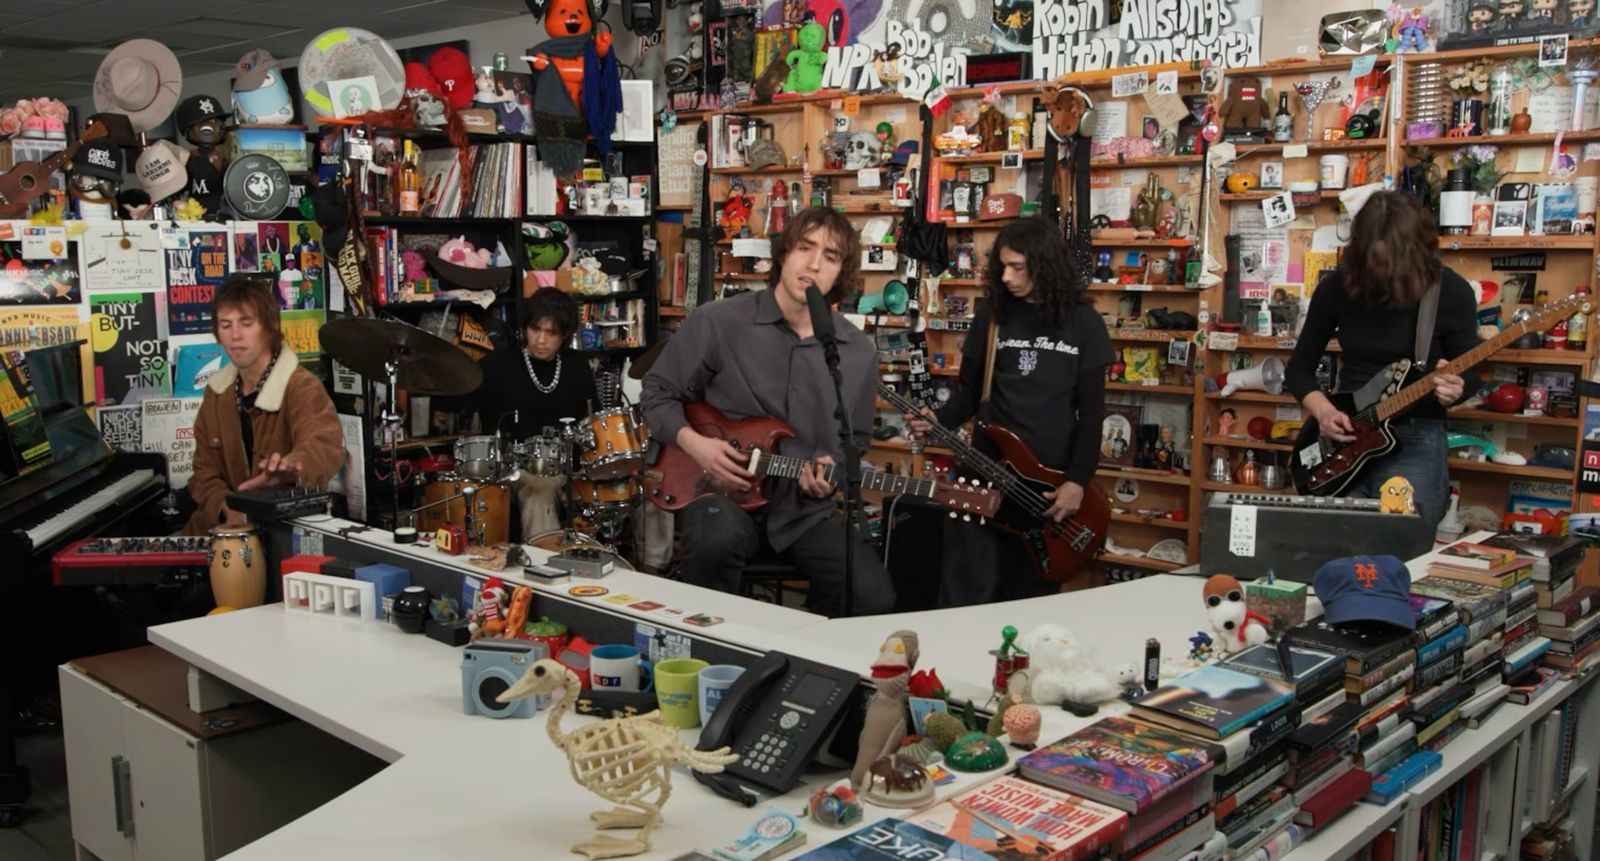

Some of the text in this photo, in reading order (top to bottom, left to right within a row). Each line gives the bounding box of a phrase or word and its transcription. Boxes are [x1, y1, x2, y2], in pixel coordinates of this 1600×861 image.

[886, 18, 932, 59] Bob
[1034, 32, 1121, 80] Hilton
[823, 44, 886, 90] NPR
[898, 42, 968, 98] Boilen
[445, 79, 456, 91] P
[658, 129, 695, 149] hilip
[192, 179, 208, 194] M
[201, 252, 226, 264] ON THE
[169, 268, 198, 286] DESK
[204, 265, 225, 277] ROAD
[349, 265, 362, 287] GIRL
[339, 265, 358, 295] MAGIC
[169, 286, 217, 304] CONTEST
[99, 302, 139, 315] TINY
[23, 313, 51, 322] MUSIC
[99, 315, 140, 332] BUT-
[125, 339, 165, 357] NOT
[1034, 336, 1054, 350] The
[1055, 340, 1079, 355] time
[139, 356, 165, 372] SO
[125, 372, 166, 389] TINY
[103, 409, 128, 424] NICK
[113, 421, 133, 433] THE
[103, 431, 141, 443] SEEDS
[171, 441, 192, 451] CAN
[1353, 562, 1379, 588] NY
[593, 674, 621, 687] npr
[980, 783, 1105, 829] MADE MUSIC
[960, 794, 1083, 841] HOW WOMEN
